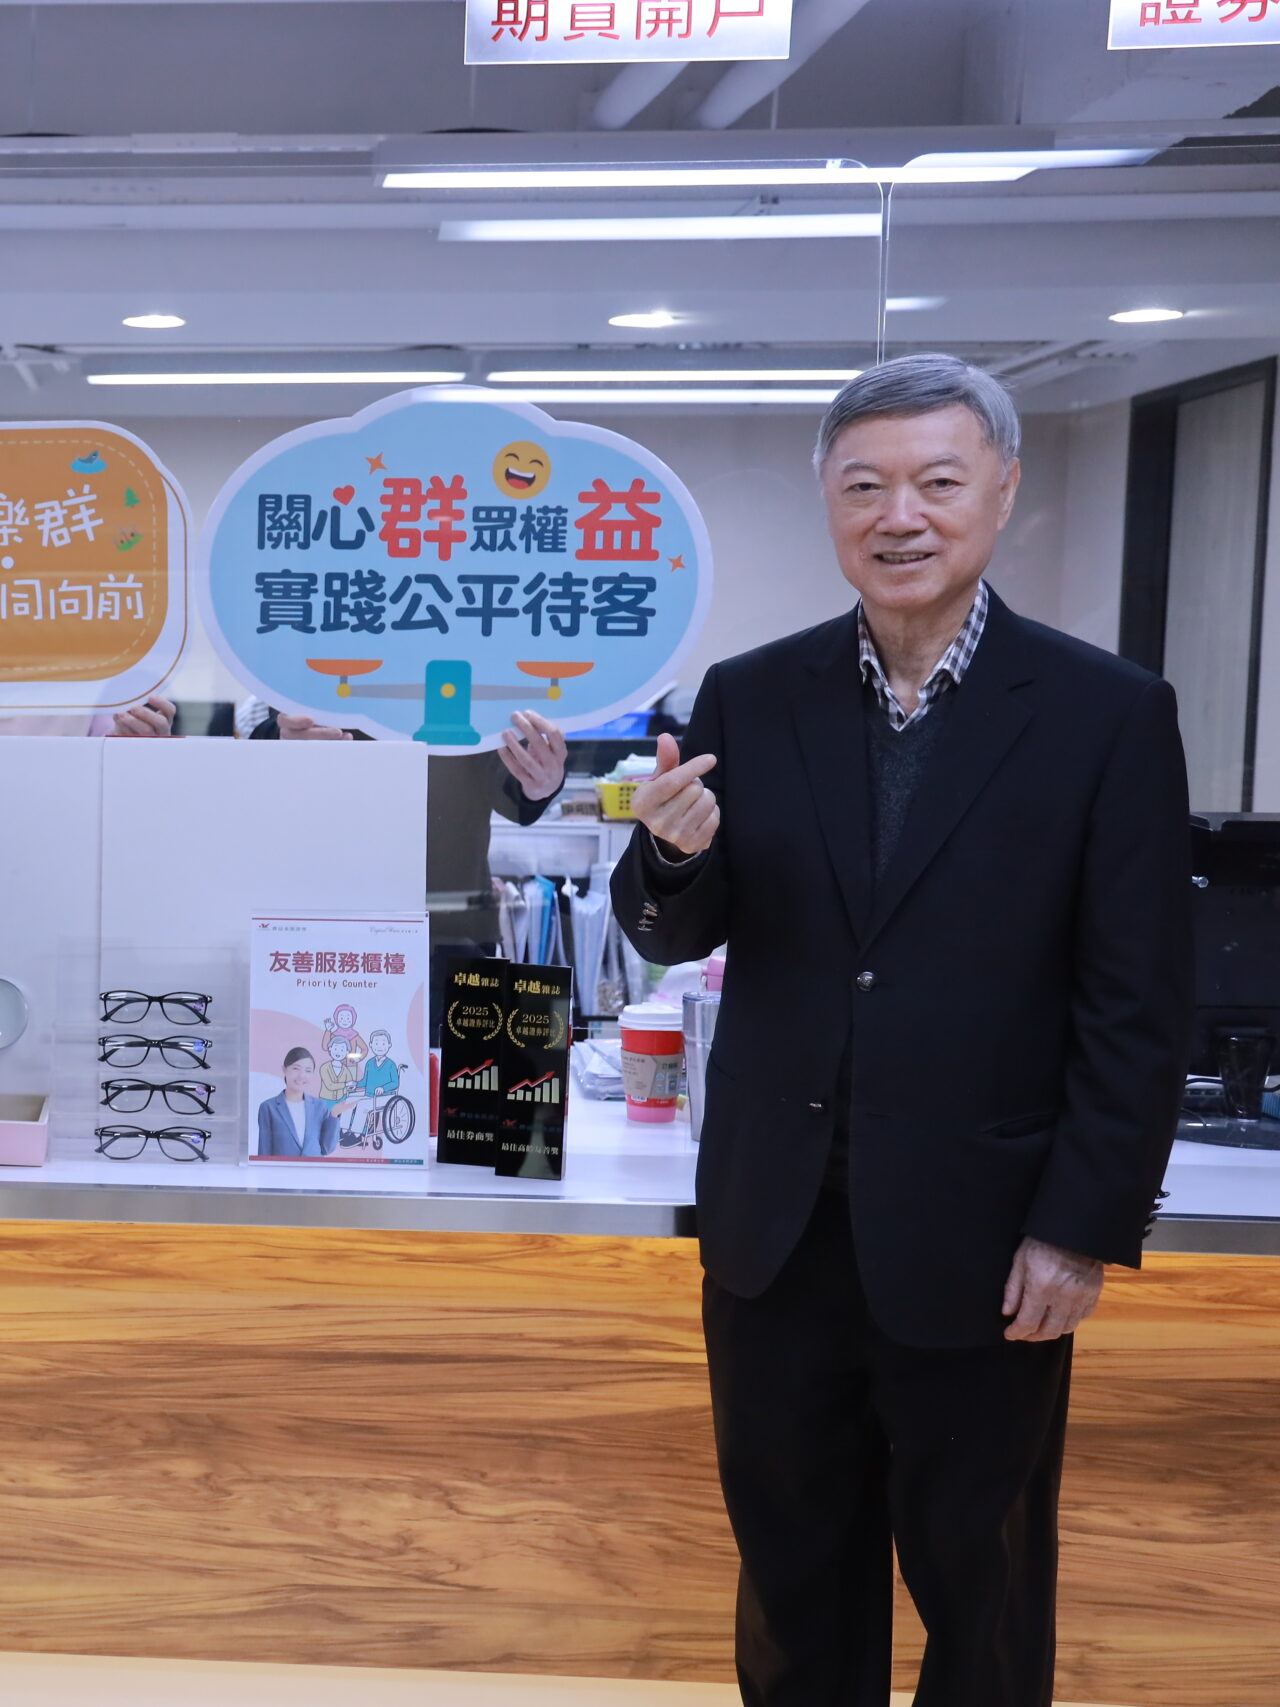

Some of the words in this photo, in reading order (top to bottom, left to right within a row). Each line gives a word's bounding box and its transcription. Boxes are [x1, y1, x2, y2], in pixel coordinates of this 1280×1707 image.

[256, 474, 663, 562] 關心群眾權益
[254, 568, 657, 638] 實踐公平待客
[269, 950, 406, 975] 友善服務櫃檯
[296, 978, 338, 990] Priority
[342, 979, 378, 989] Counter
[462, 1006, 489, 1017] 2025
[522, 1014, 550, 1025] 2025
